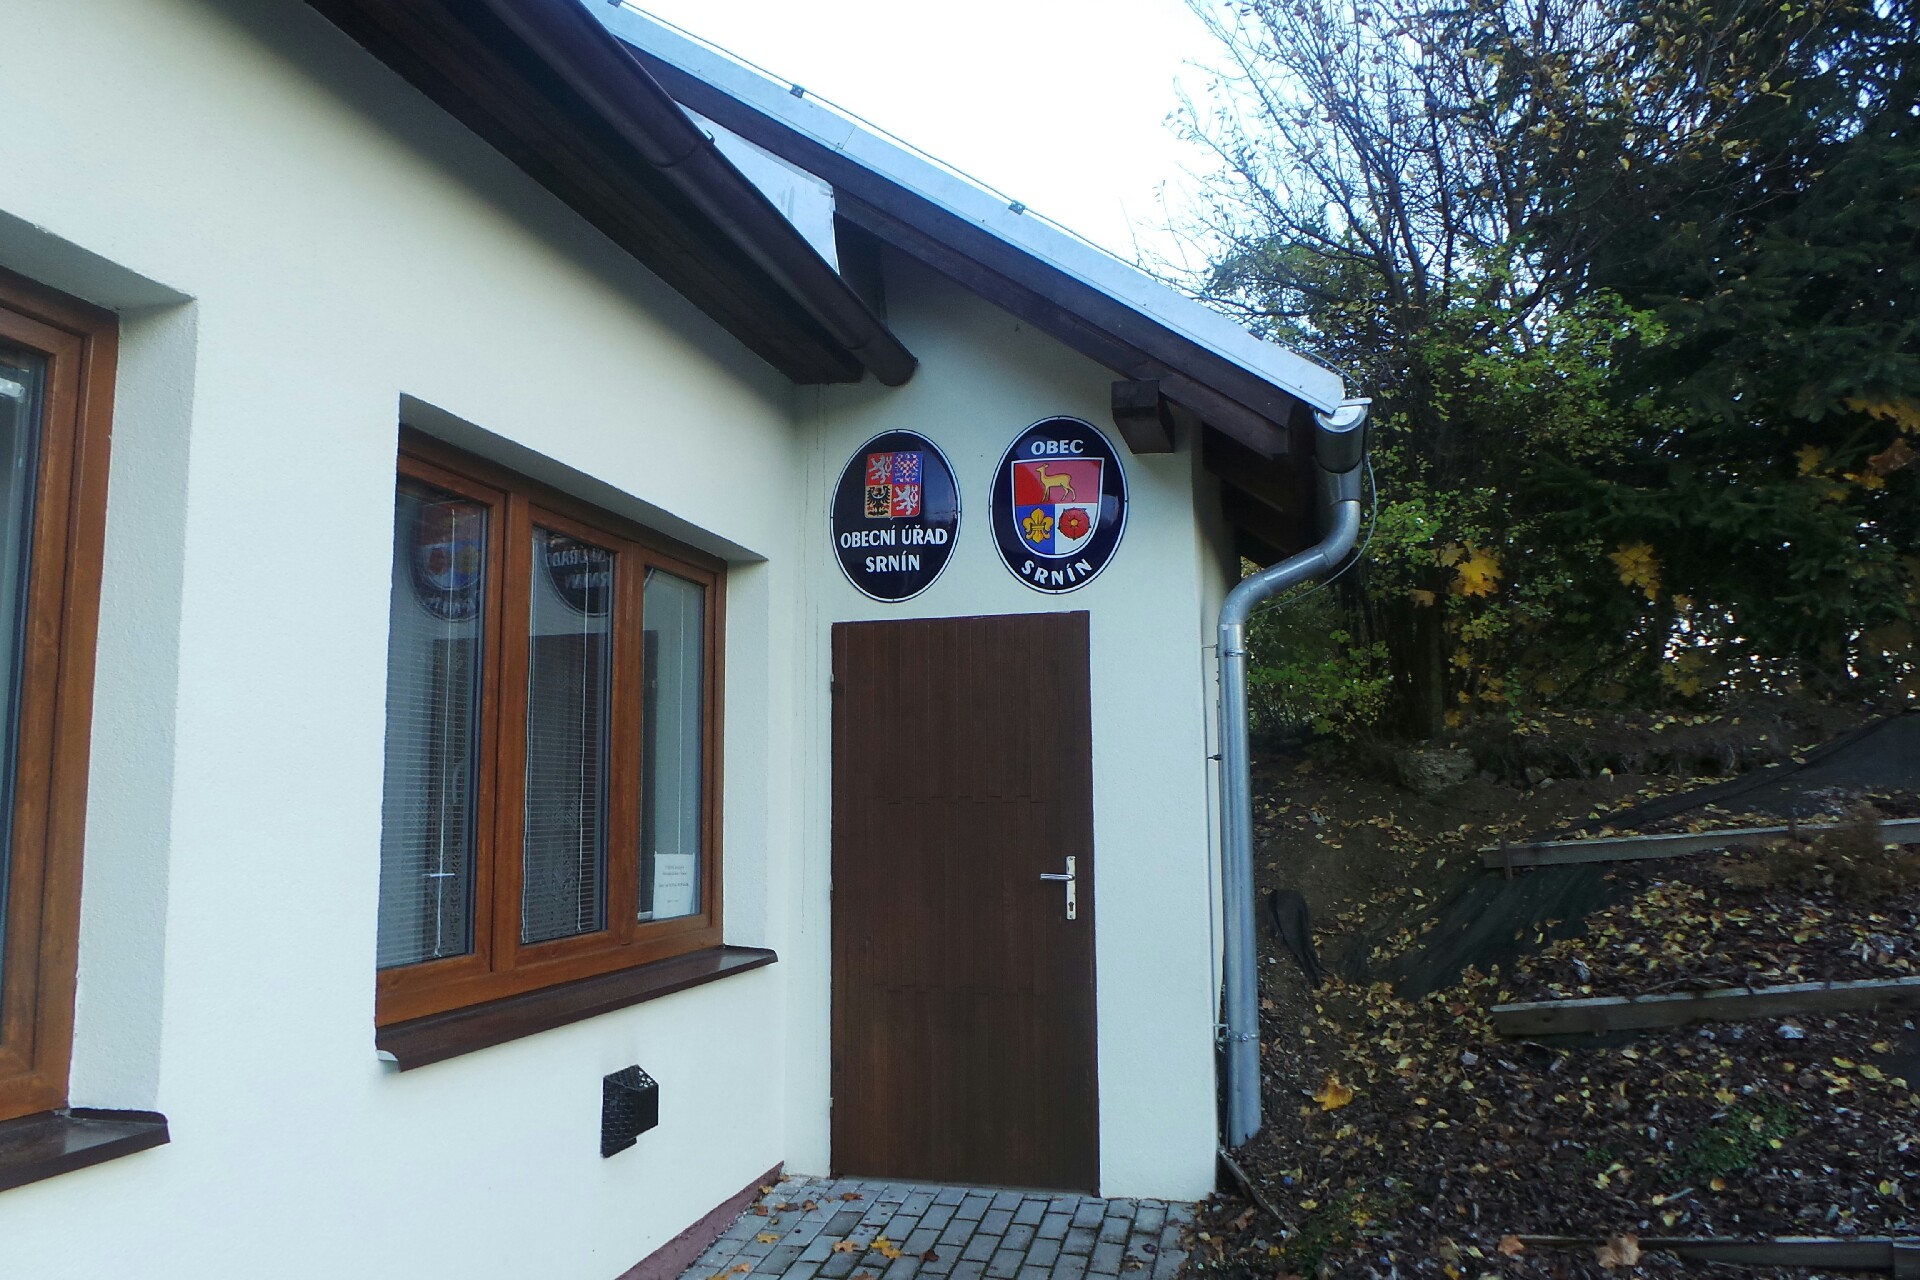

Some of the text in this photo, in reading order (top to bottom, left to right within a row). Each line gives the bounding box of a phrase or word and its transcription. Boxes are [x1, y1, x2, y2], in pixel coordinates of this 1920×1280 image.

[1031, 439, 1084, 455] OBEC
[840, 524, 948, 549] OBECNÍ ÚŘAD
[865, 551, 920, 573] SRNÍN
[1021, 558, 1093, 586] SRNÍN
